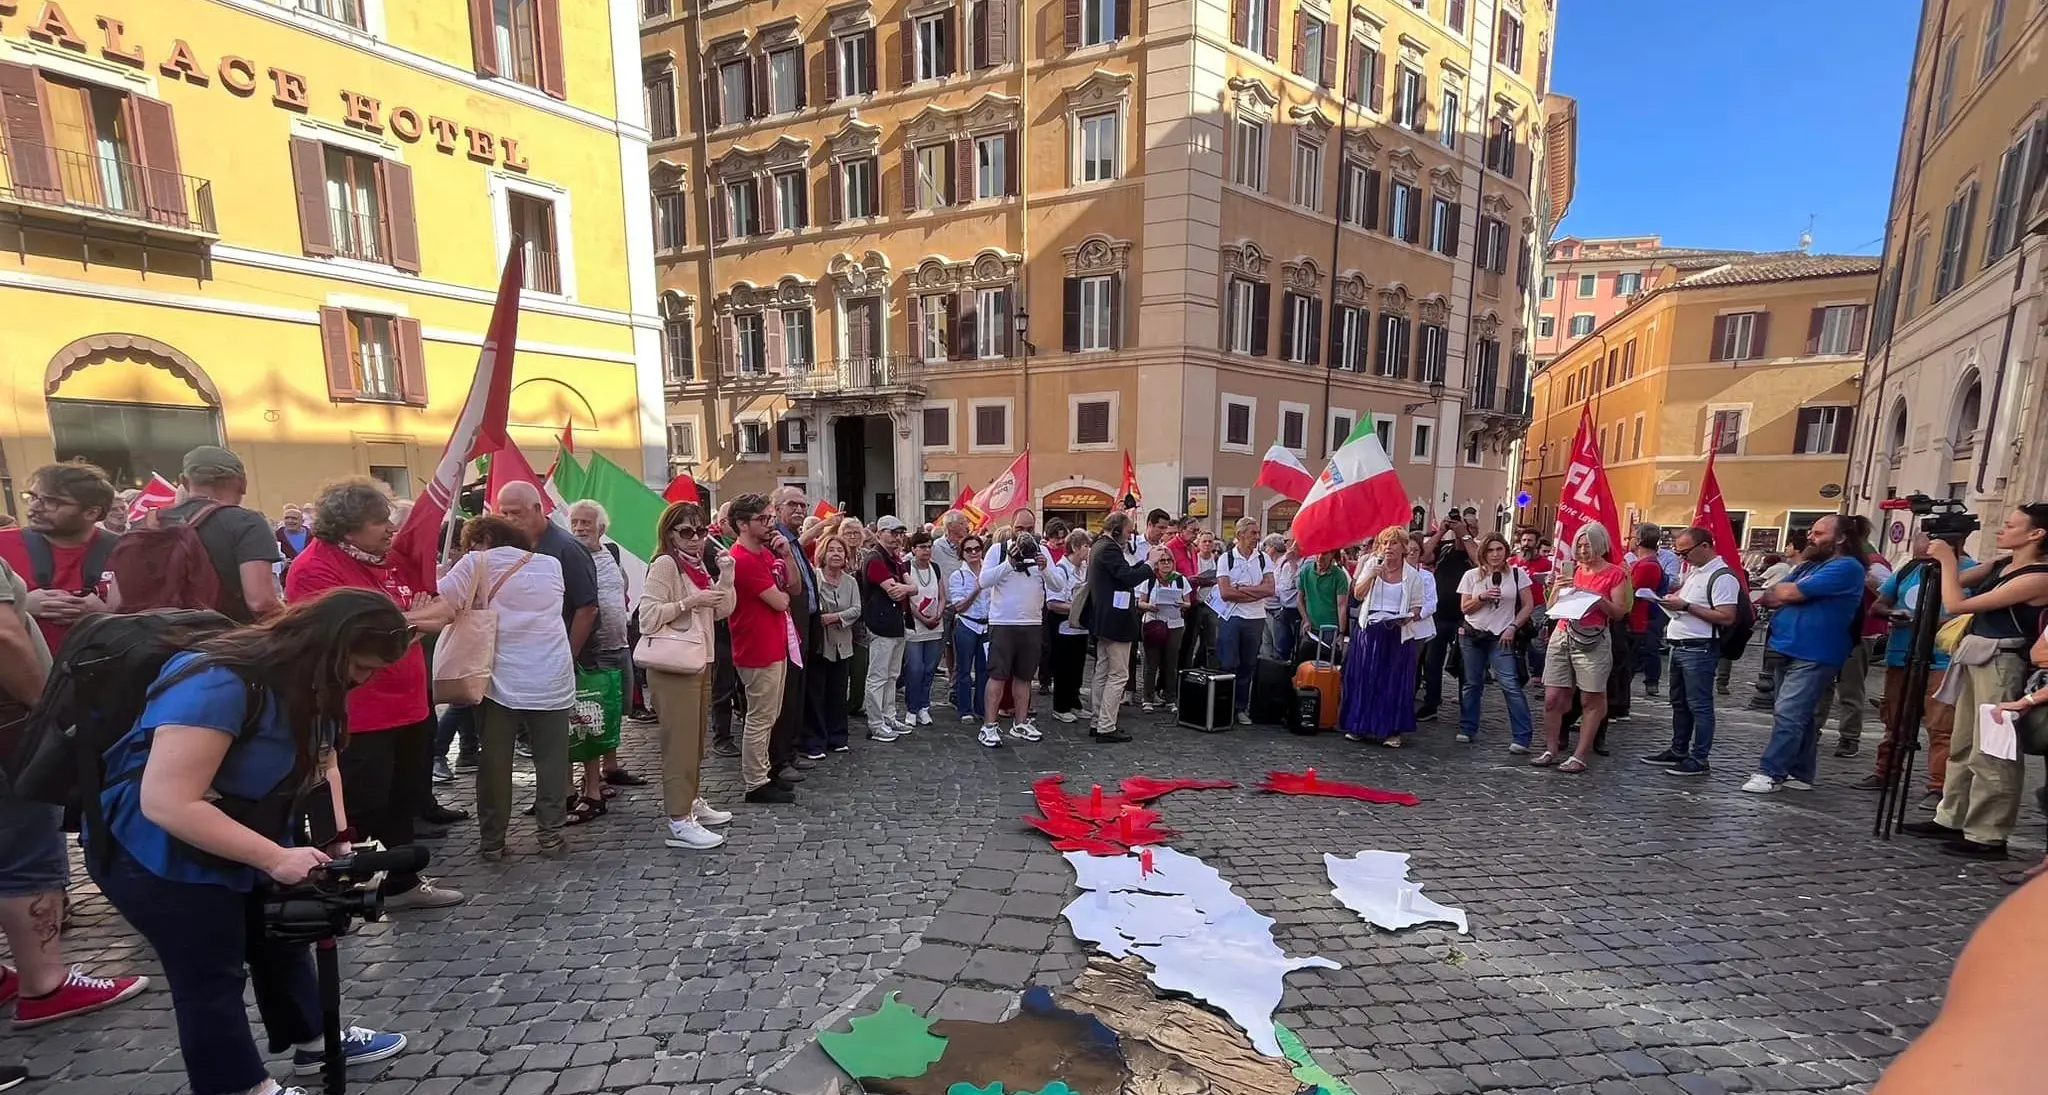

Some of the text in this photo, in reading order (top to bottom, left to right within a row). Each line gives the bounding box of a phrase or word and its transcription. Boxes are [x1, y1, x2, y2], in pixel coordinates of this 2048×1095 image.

[0, 0, 529, 174] ALACE HOTEL
[1059, 494, 1099, 505] DHL
[1562, 461, 1600, 511] FL
